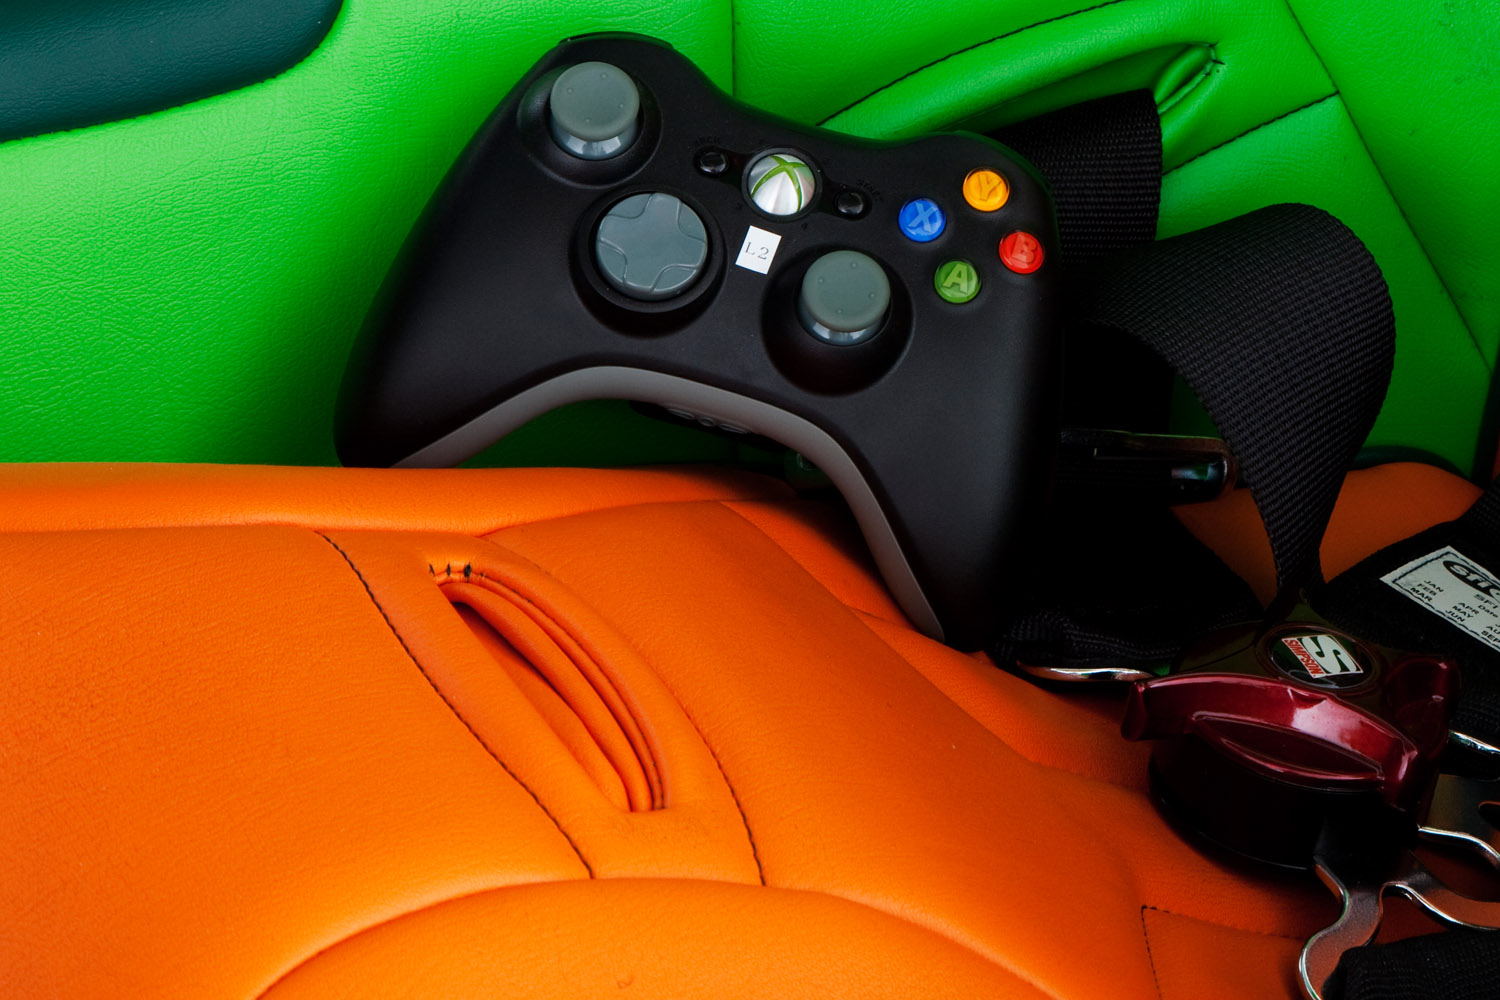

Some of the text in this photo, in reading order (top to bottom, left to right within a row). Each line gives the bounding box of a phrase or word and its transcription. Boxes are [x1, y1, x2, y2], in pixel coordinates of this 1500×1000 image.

[976, 173, 1002, 201] Y
[908, 201, 936, 233] X
[1012, 233, 1037, 264] B
[943, 263, 969, 294] A
[1417, 583, 1437, 596] FEB
[1452, 605, 1474, 618] MAY
[1423, 580, 1444, 592] JAN
[1458, 602, 1480, 615] APR
[1473, 594, 1498, 609] SFI
[1478, 604, 1499, 618] Date
[1410, 587, 1433, 602] MAR
[1445, 610, 1466, 622] JUN
[1481, 630, 1500, 643] SEP
[1284, 639, 1325, 675] SIMPSON
